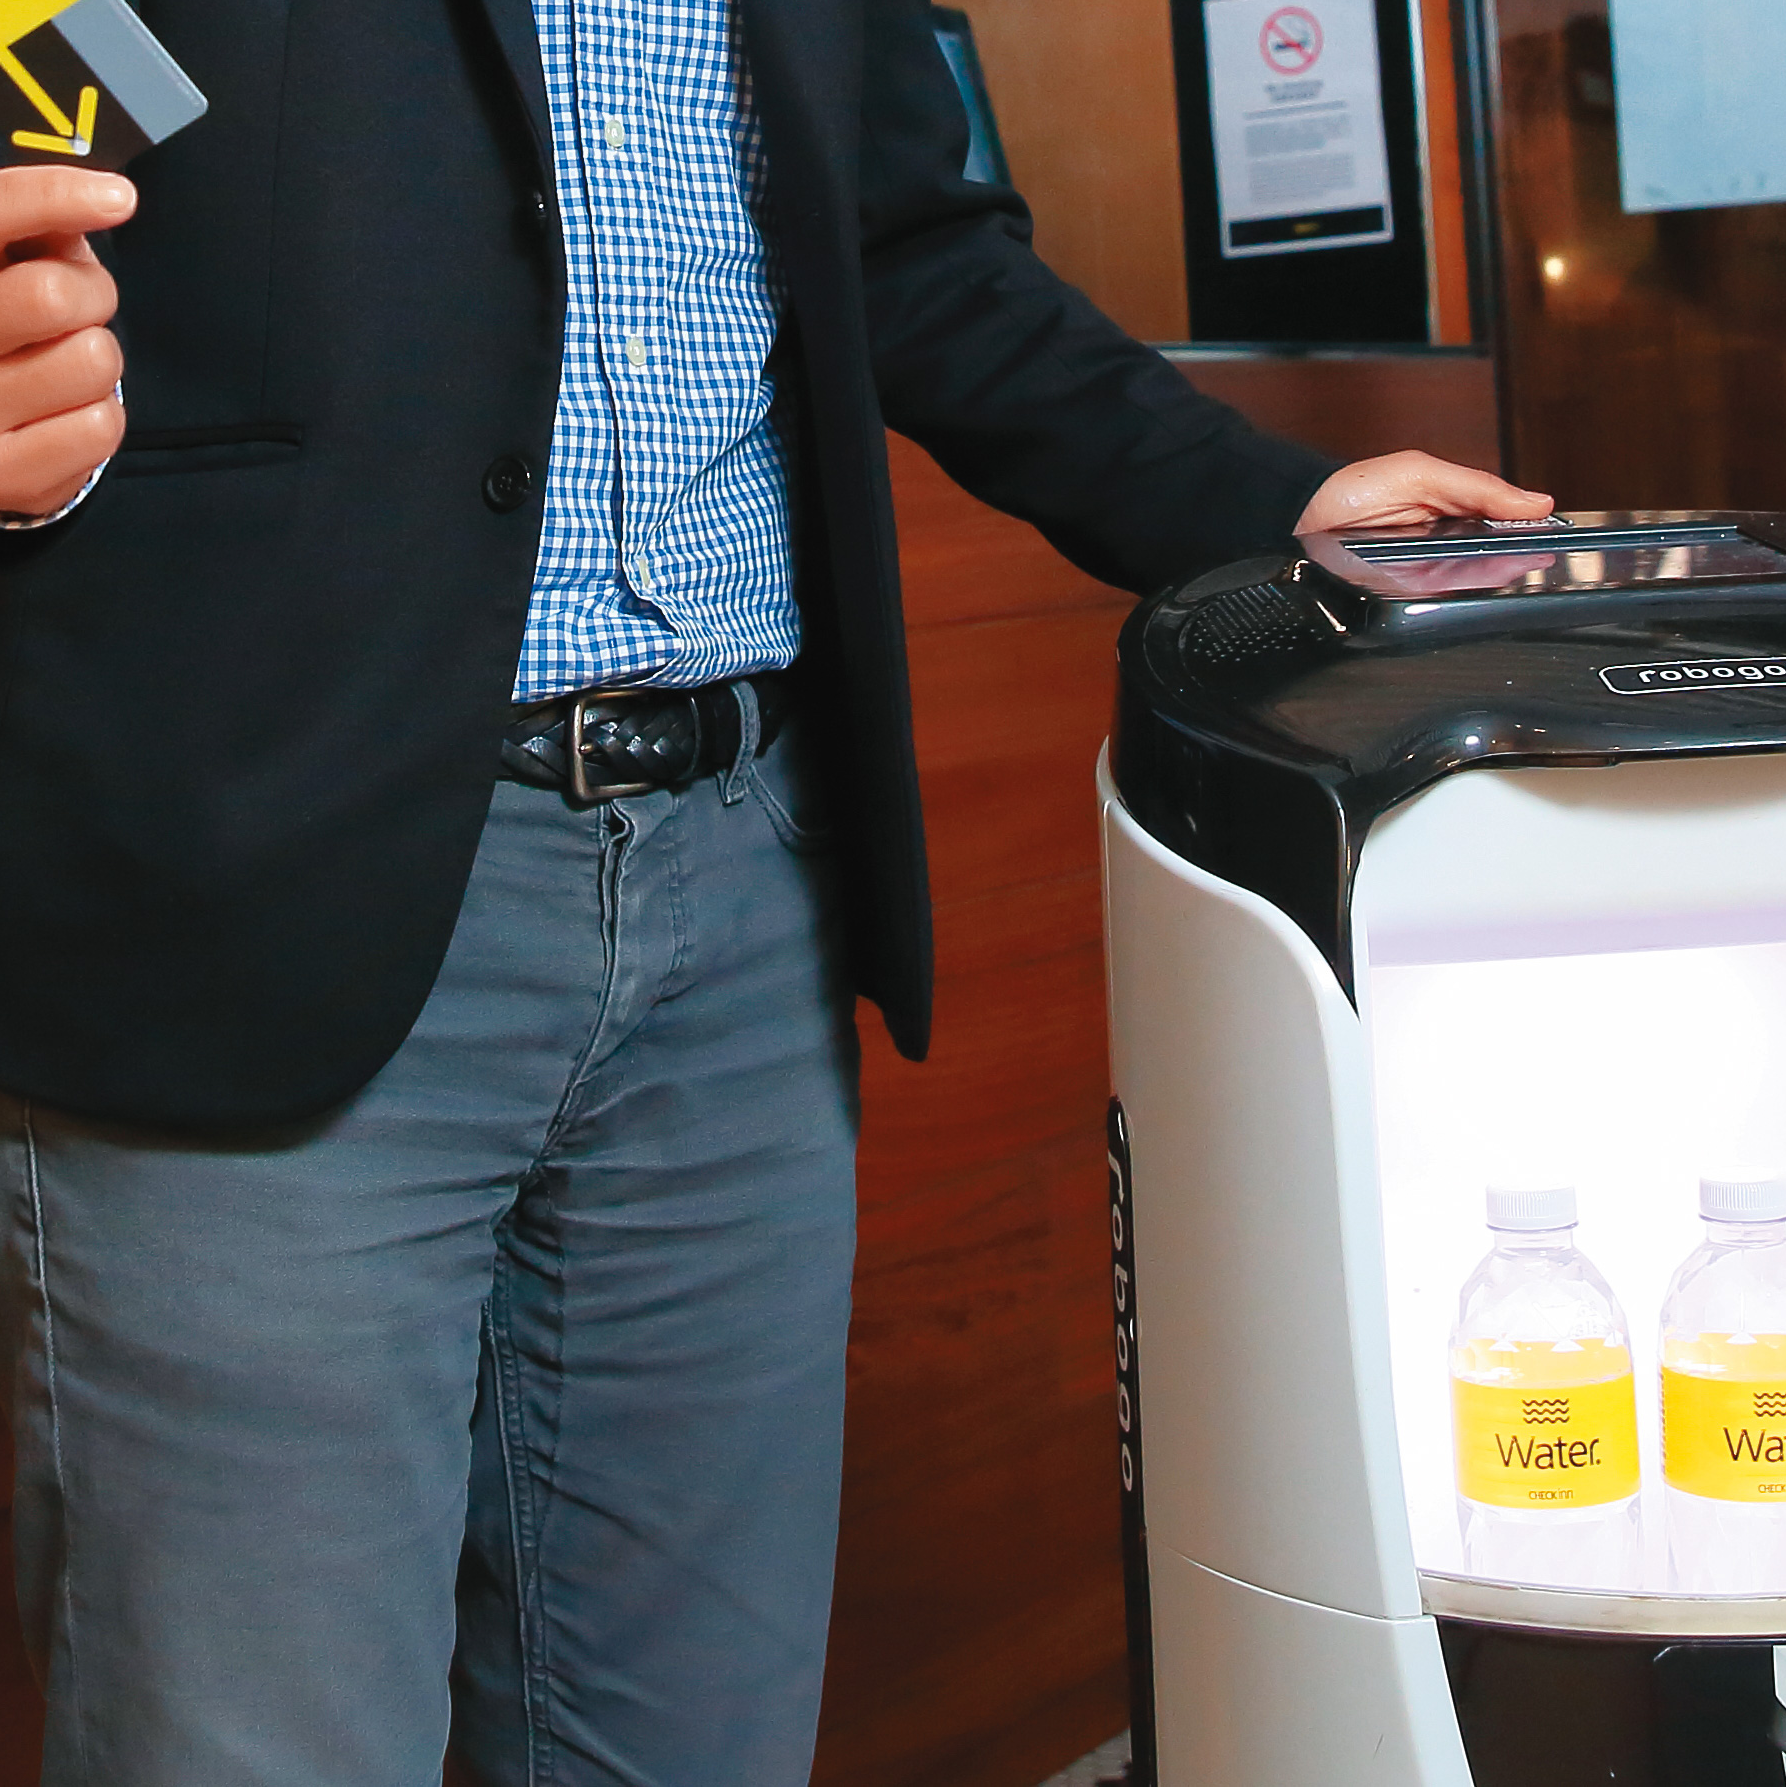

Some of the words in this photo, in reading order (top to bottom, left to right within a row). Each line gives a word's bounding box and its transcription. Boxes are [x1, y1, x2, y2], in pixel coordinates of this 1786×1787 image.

[1638, 665, 1786, 683] robogo
[1108, 1150, 1132, 1492] robogo
[1495, 1432, 1601, 1469] Water.
